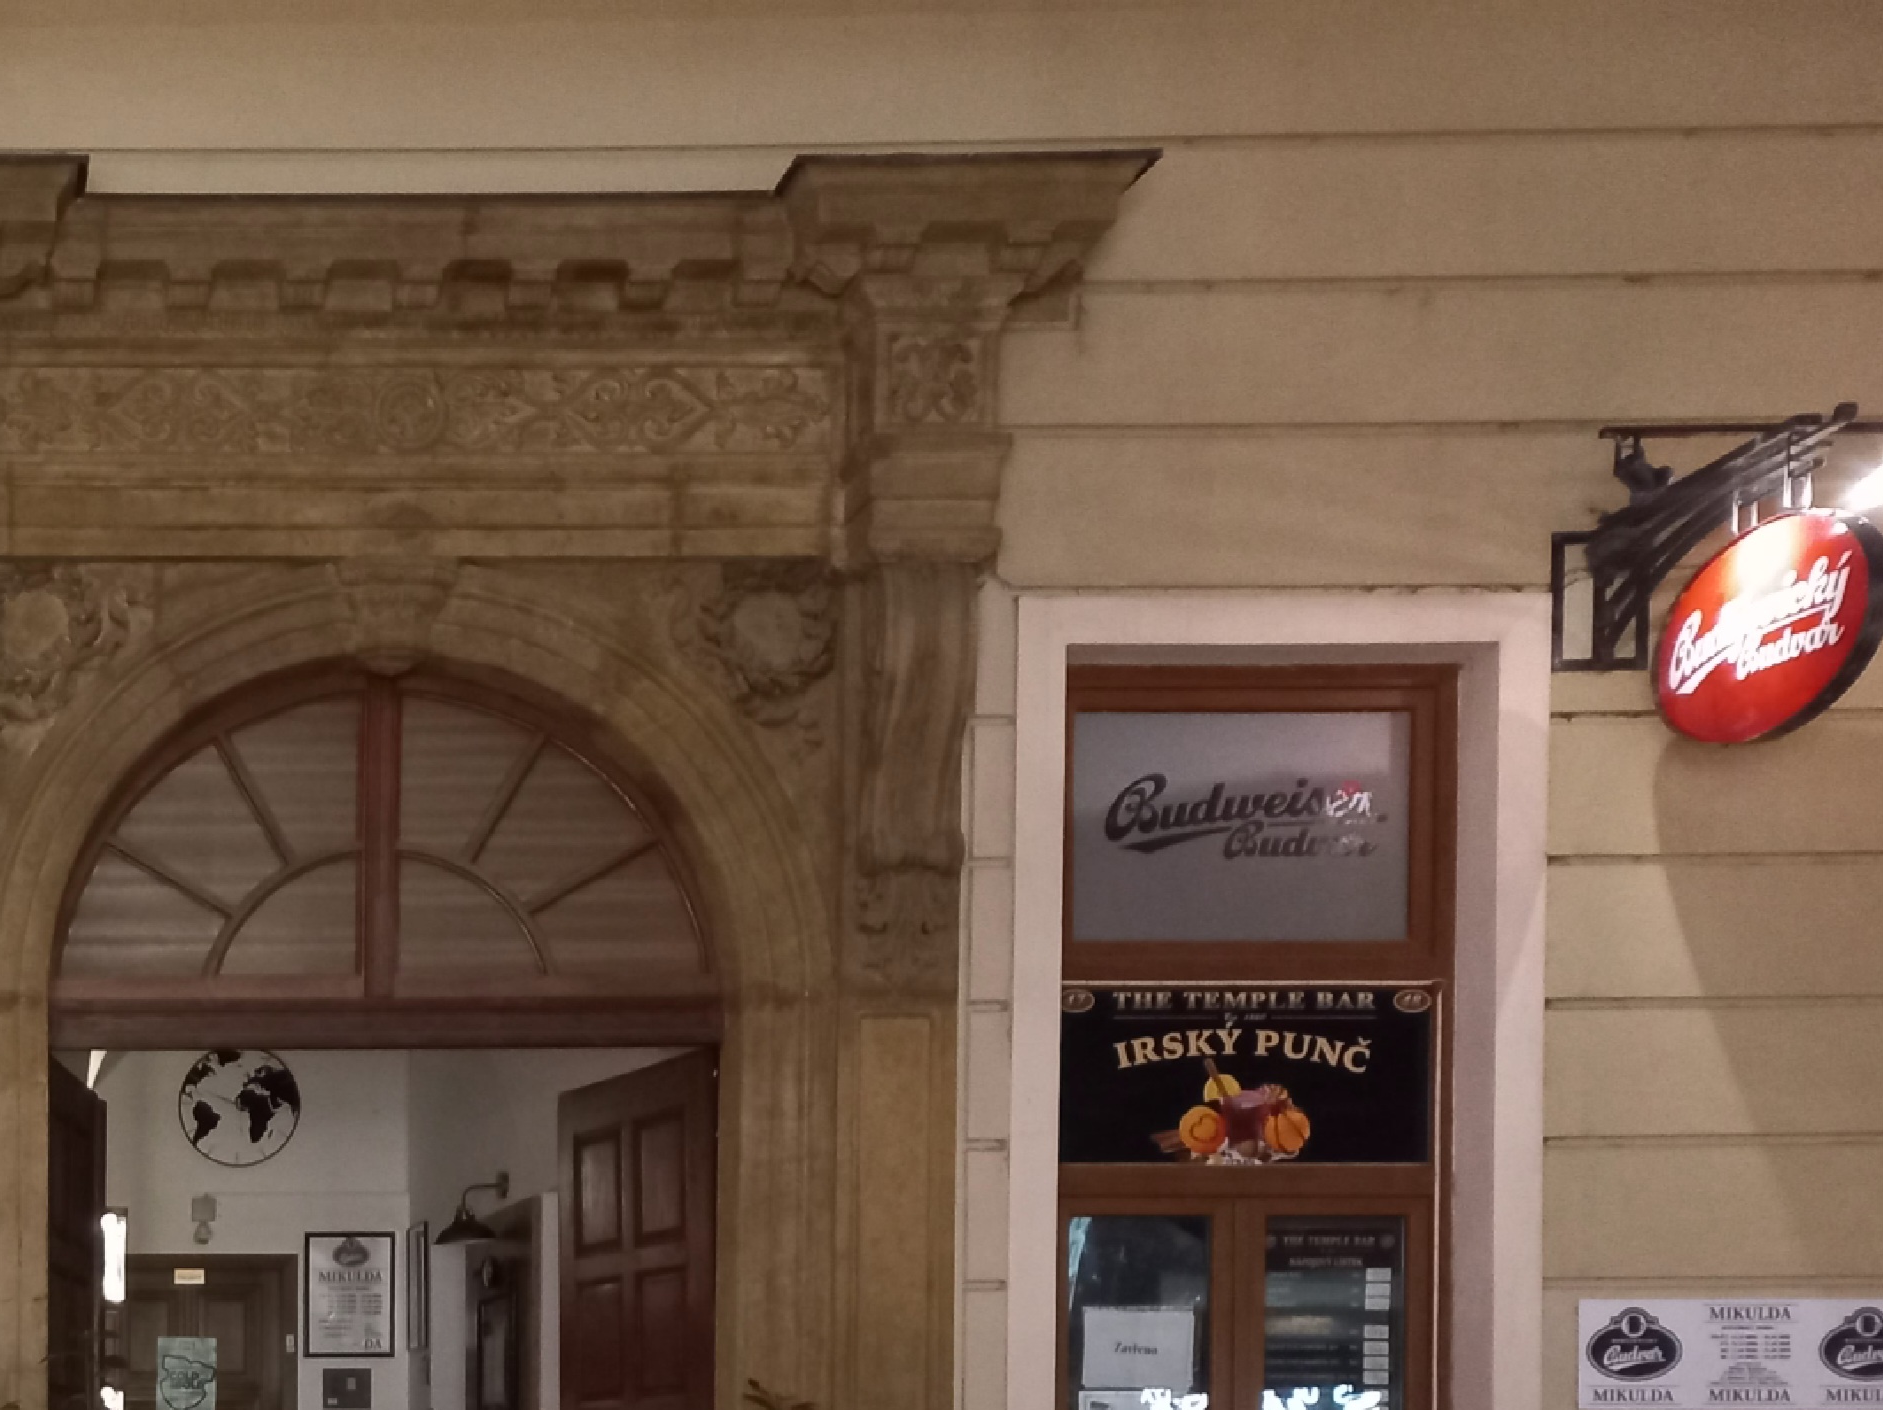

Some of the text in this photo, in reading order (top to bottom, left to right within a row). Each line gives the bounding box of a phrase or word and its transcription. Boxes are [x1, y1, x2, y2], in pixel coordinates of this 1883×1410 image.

[1113, 991, 1376, 1010] THE TEMPLE BAR
[1114, 1018, 1373, 1073] IRSKÝ PUNČ
[318, 1271, 382, 1282] MIKULDA
[1709, 1306, 1791, 1320] MIKULDA
[1593, 1388, 1674, 1402] MIKULDA
[1708, 1388, 1791, 1402] MIKULDA
